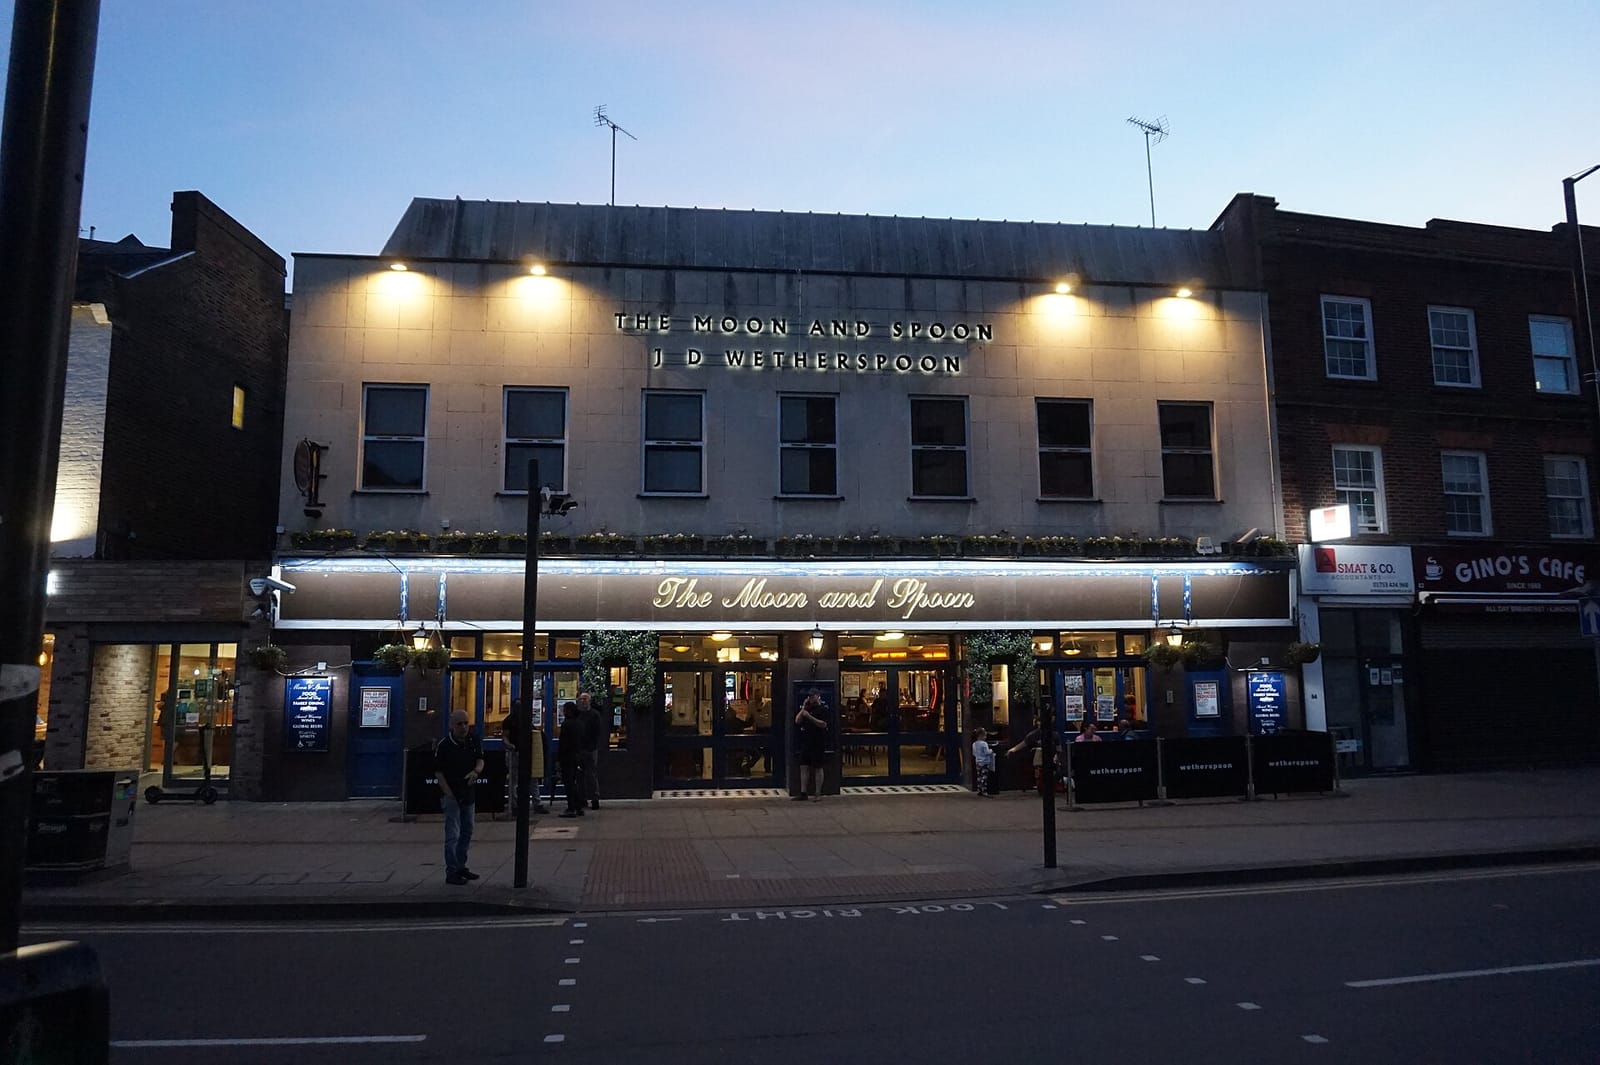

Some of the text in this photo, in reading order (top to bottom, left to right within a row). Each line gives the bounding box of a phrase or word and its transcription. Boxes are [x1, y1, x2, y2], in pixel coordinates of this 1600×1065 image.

[615, 313, 993, 341] THE MOON AND SPOON
[653, 348, 961, 373] J D WETHERSPOON
[1370, 563, 1377, 574] &
[1379, 563, 1396, 574] CO.
[1455, 556, 1529, 583] GINO'S
[653, 577, 975, 619] The Moon and Spoon
[1089, 767, 1143, 776] wetherspoon
[1179, 762, 1233, 771] wetherspoon
[1267, 760, 1320, 768] wetherspoon
[720, 902, 1009, 922] LOOK RIGHT
